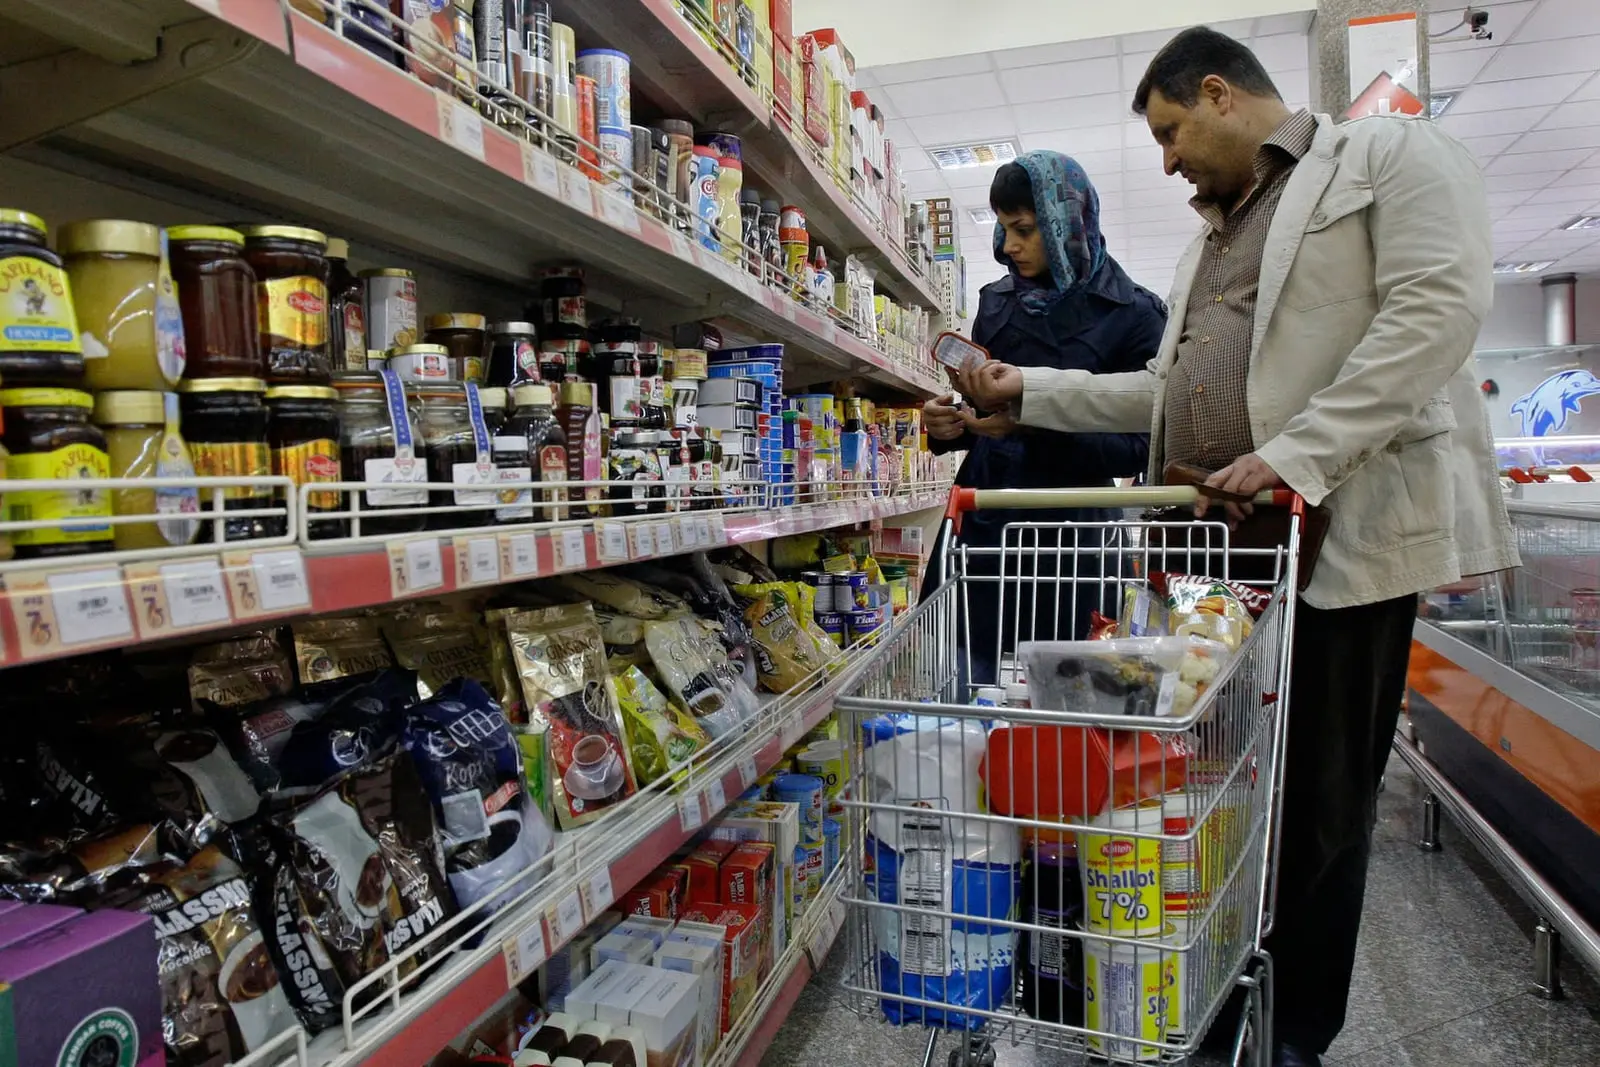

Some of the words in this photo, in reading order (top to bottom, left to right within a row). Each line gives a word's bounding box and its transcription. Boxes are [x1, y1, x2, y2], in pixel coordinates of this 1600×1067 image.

[53, 449, 107, 479] CAPILAN
[1087, 868, 1155, 889] Shallot
[1096, 890, 1149, 921] 7%
